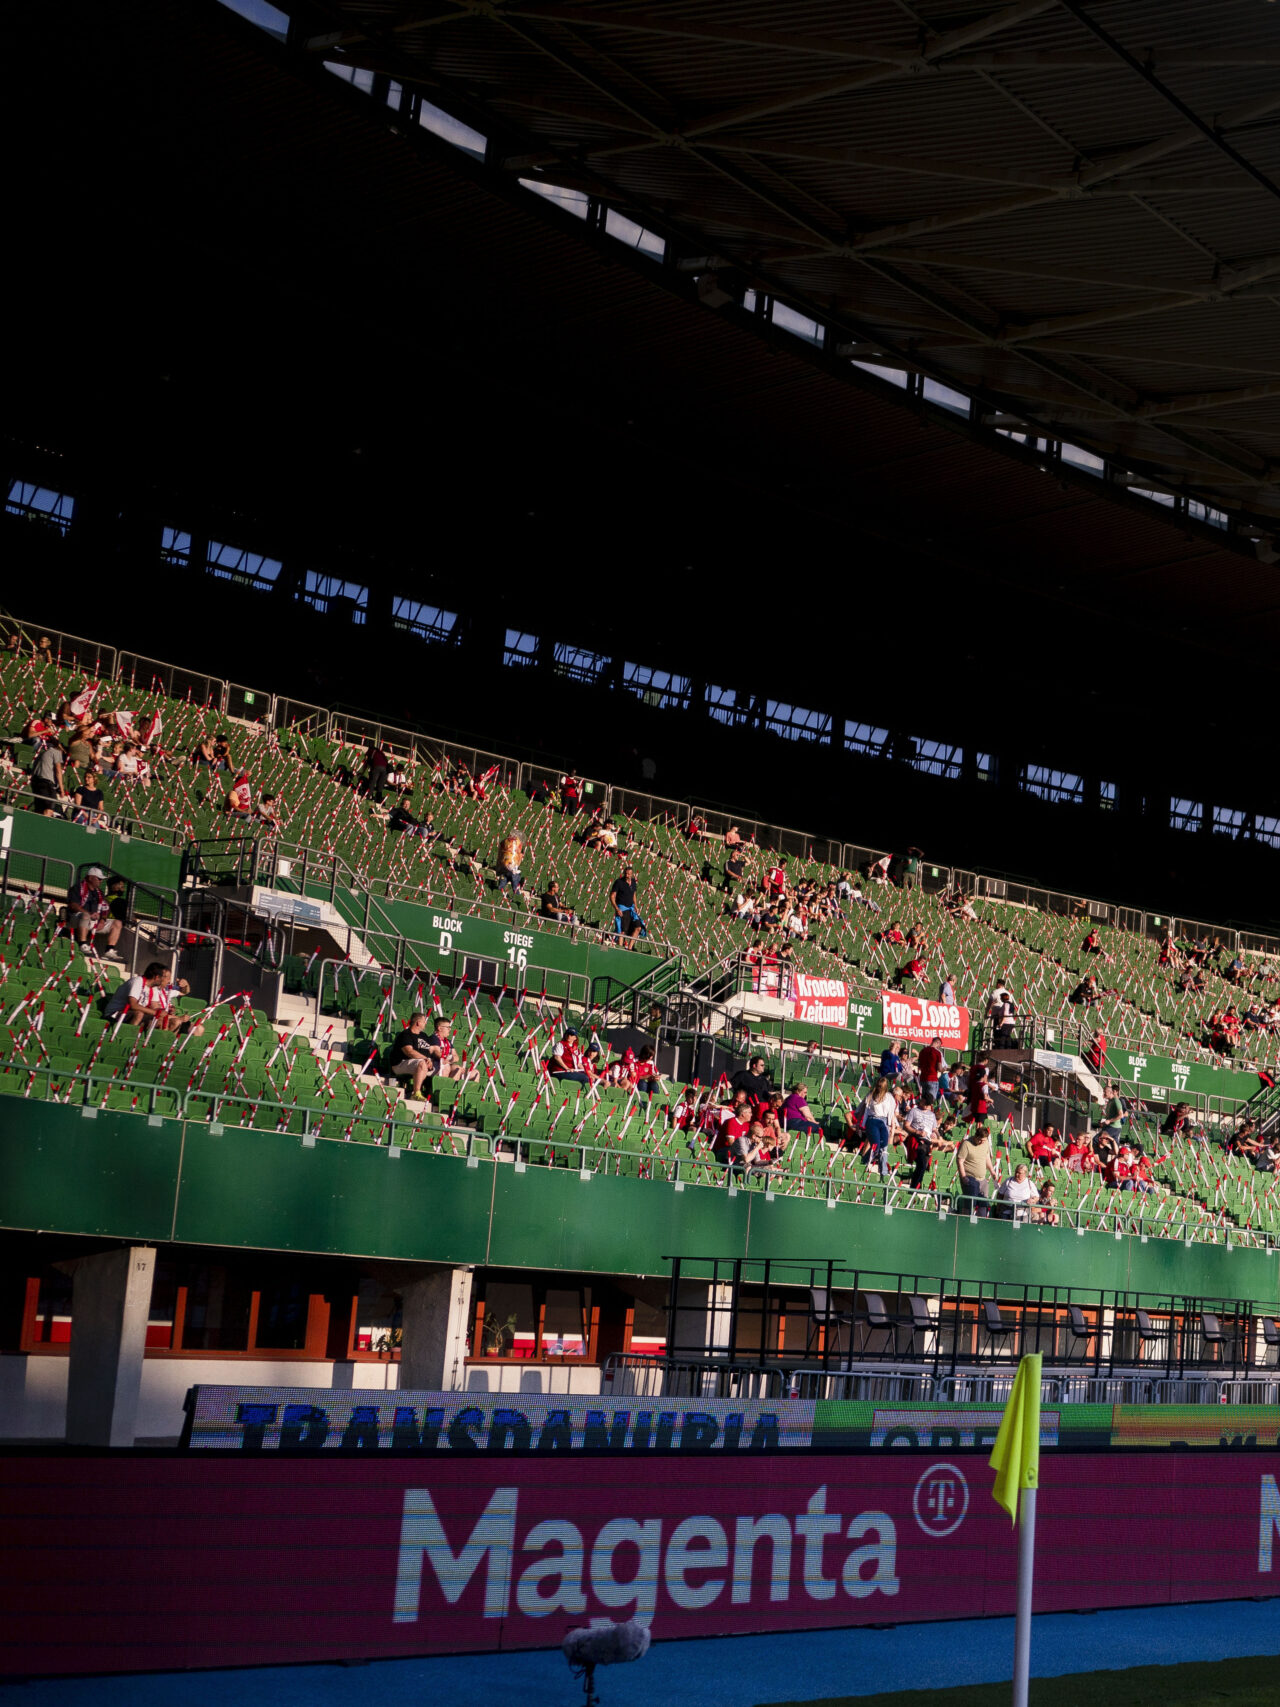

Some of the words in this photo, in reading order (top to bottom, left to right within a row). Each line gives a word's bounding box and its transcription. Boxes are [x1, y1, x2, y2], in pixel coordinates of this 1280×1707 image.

[432, 915, 463, 933] BLOCK
[438, 931, 453, 956] D
[503, 930, 534, 949] STIEGE
[507, 946, 528, 972] 16
[797, 974, 846, 998] Kronen
[800, 1000, 847, 1027] Zeitung
[850, 1003, 872, 1017] BLOCK
[882, 994, 960, 1029] Fan-Zone
[884, 1026, 908, 1037] ALLES
[909, 1026, 924, 1039] FÜR
[925, 1029, 938, 1039] DIE
[1128, 1055, 1147, 1068] BLOCK
[1171, 1063, 1190, 1075] STIEGE
[1173, 1074, 1188, 1091] 17
[392, 1484, 900, 1629] Magenta
